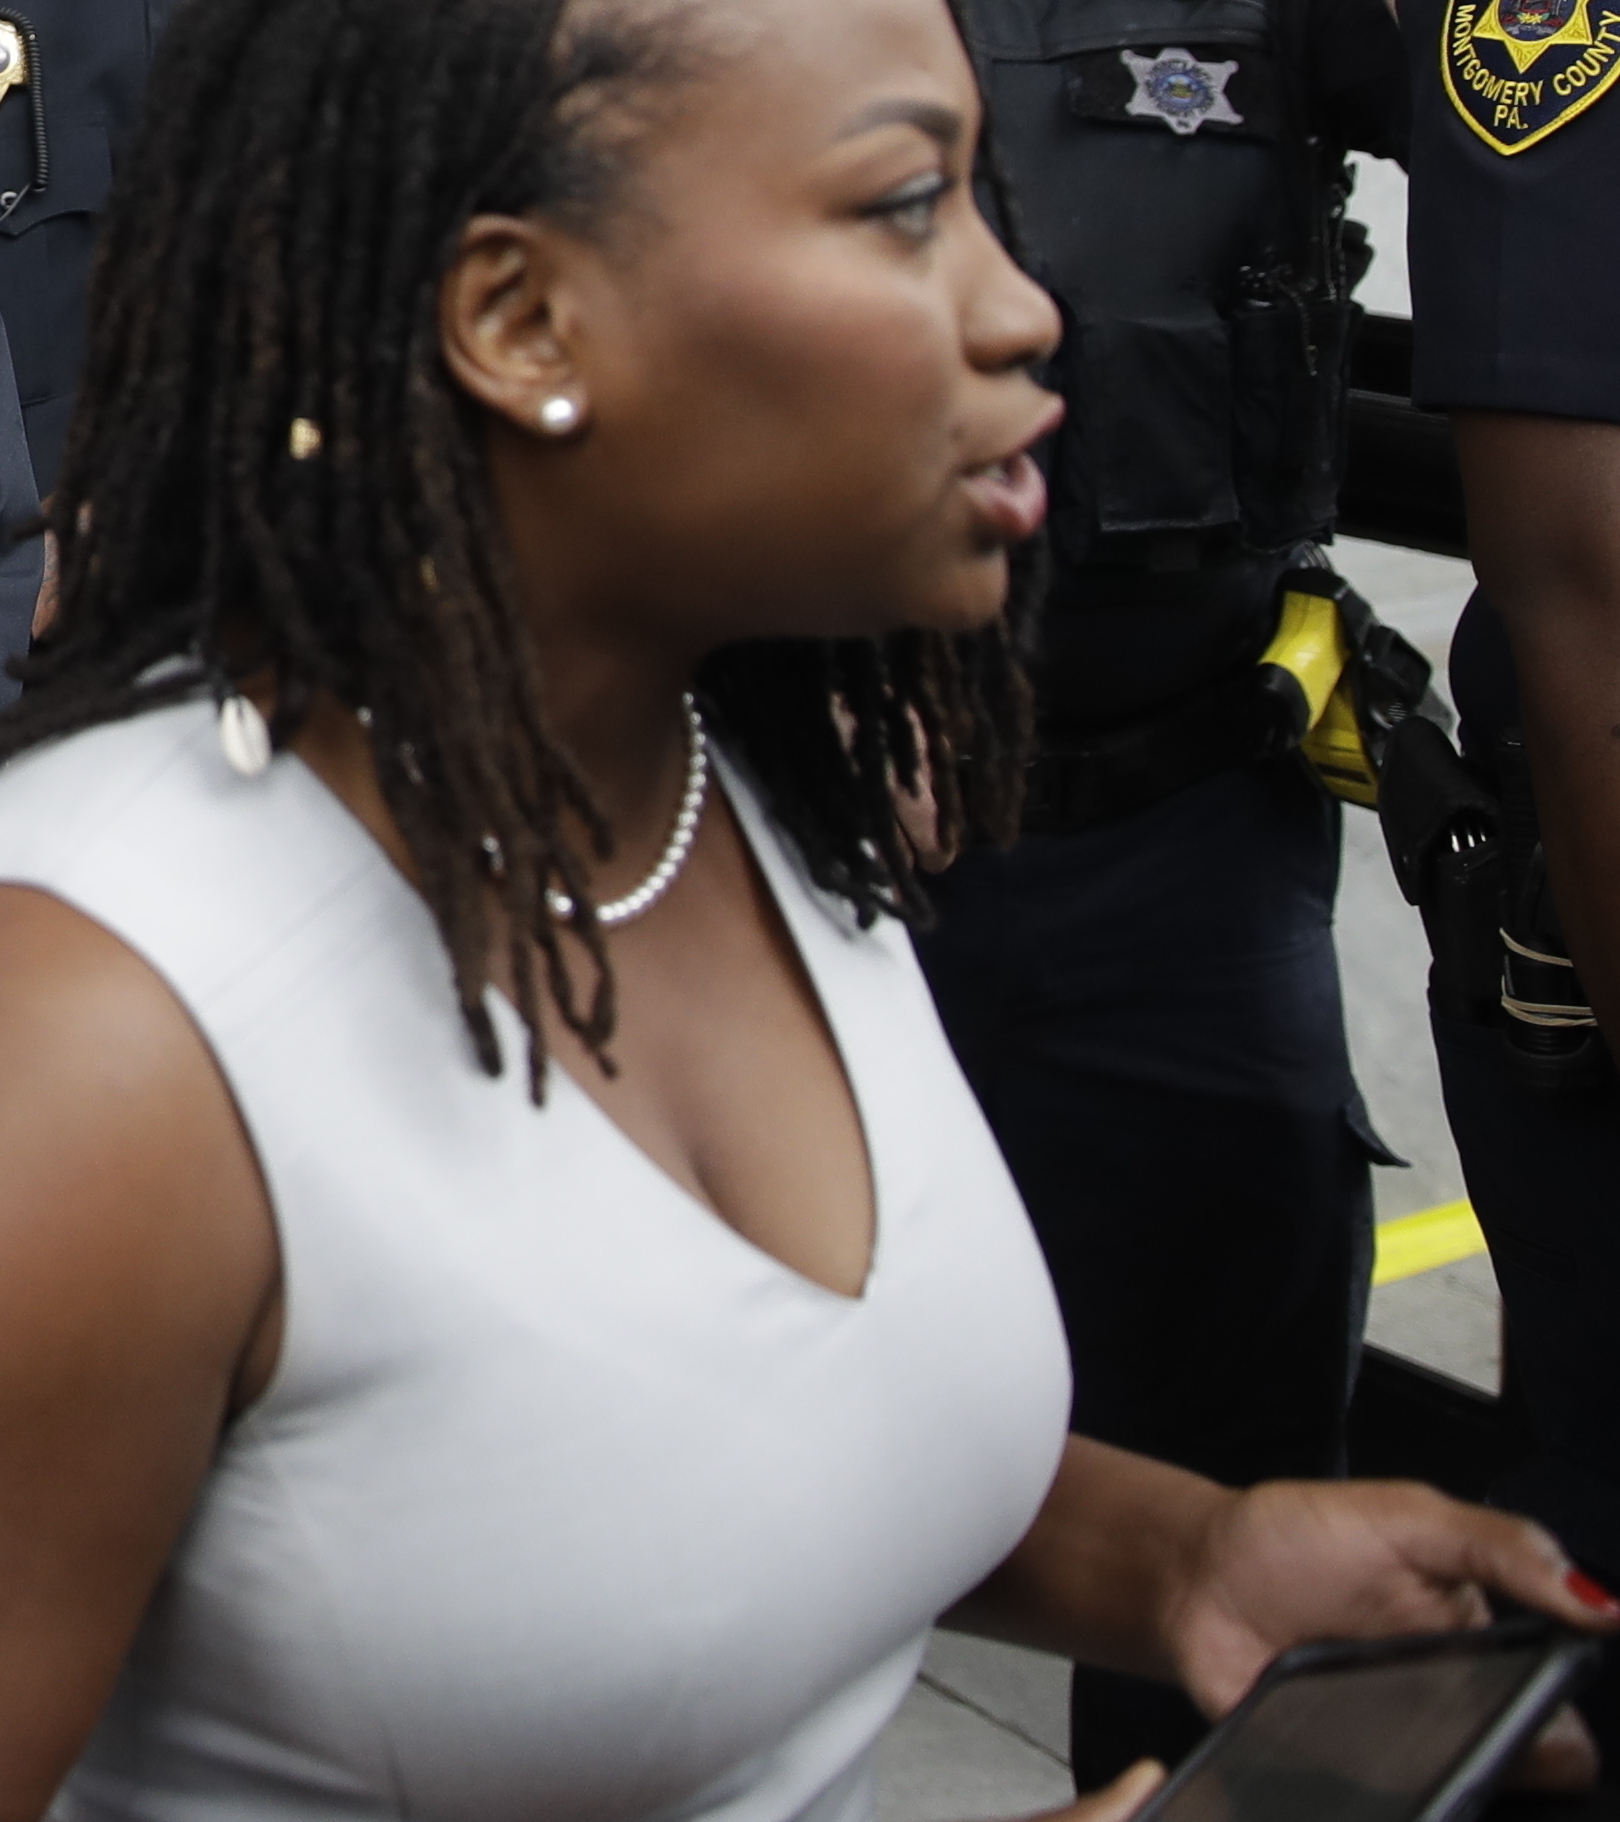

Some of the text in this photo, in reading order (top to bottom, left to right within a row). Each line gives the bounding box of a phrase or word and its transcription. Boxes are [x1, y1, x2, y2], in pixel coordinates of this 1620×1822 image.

[1453, 4, 1620, 106] MONTGOMERY COUNTY
[1494, 106, 1529, 129] PA.
